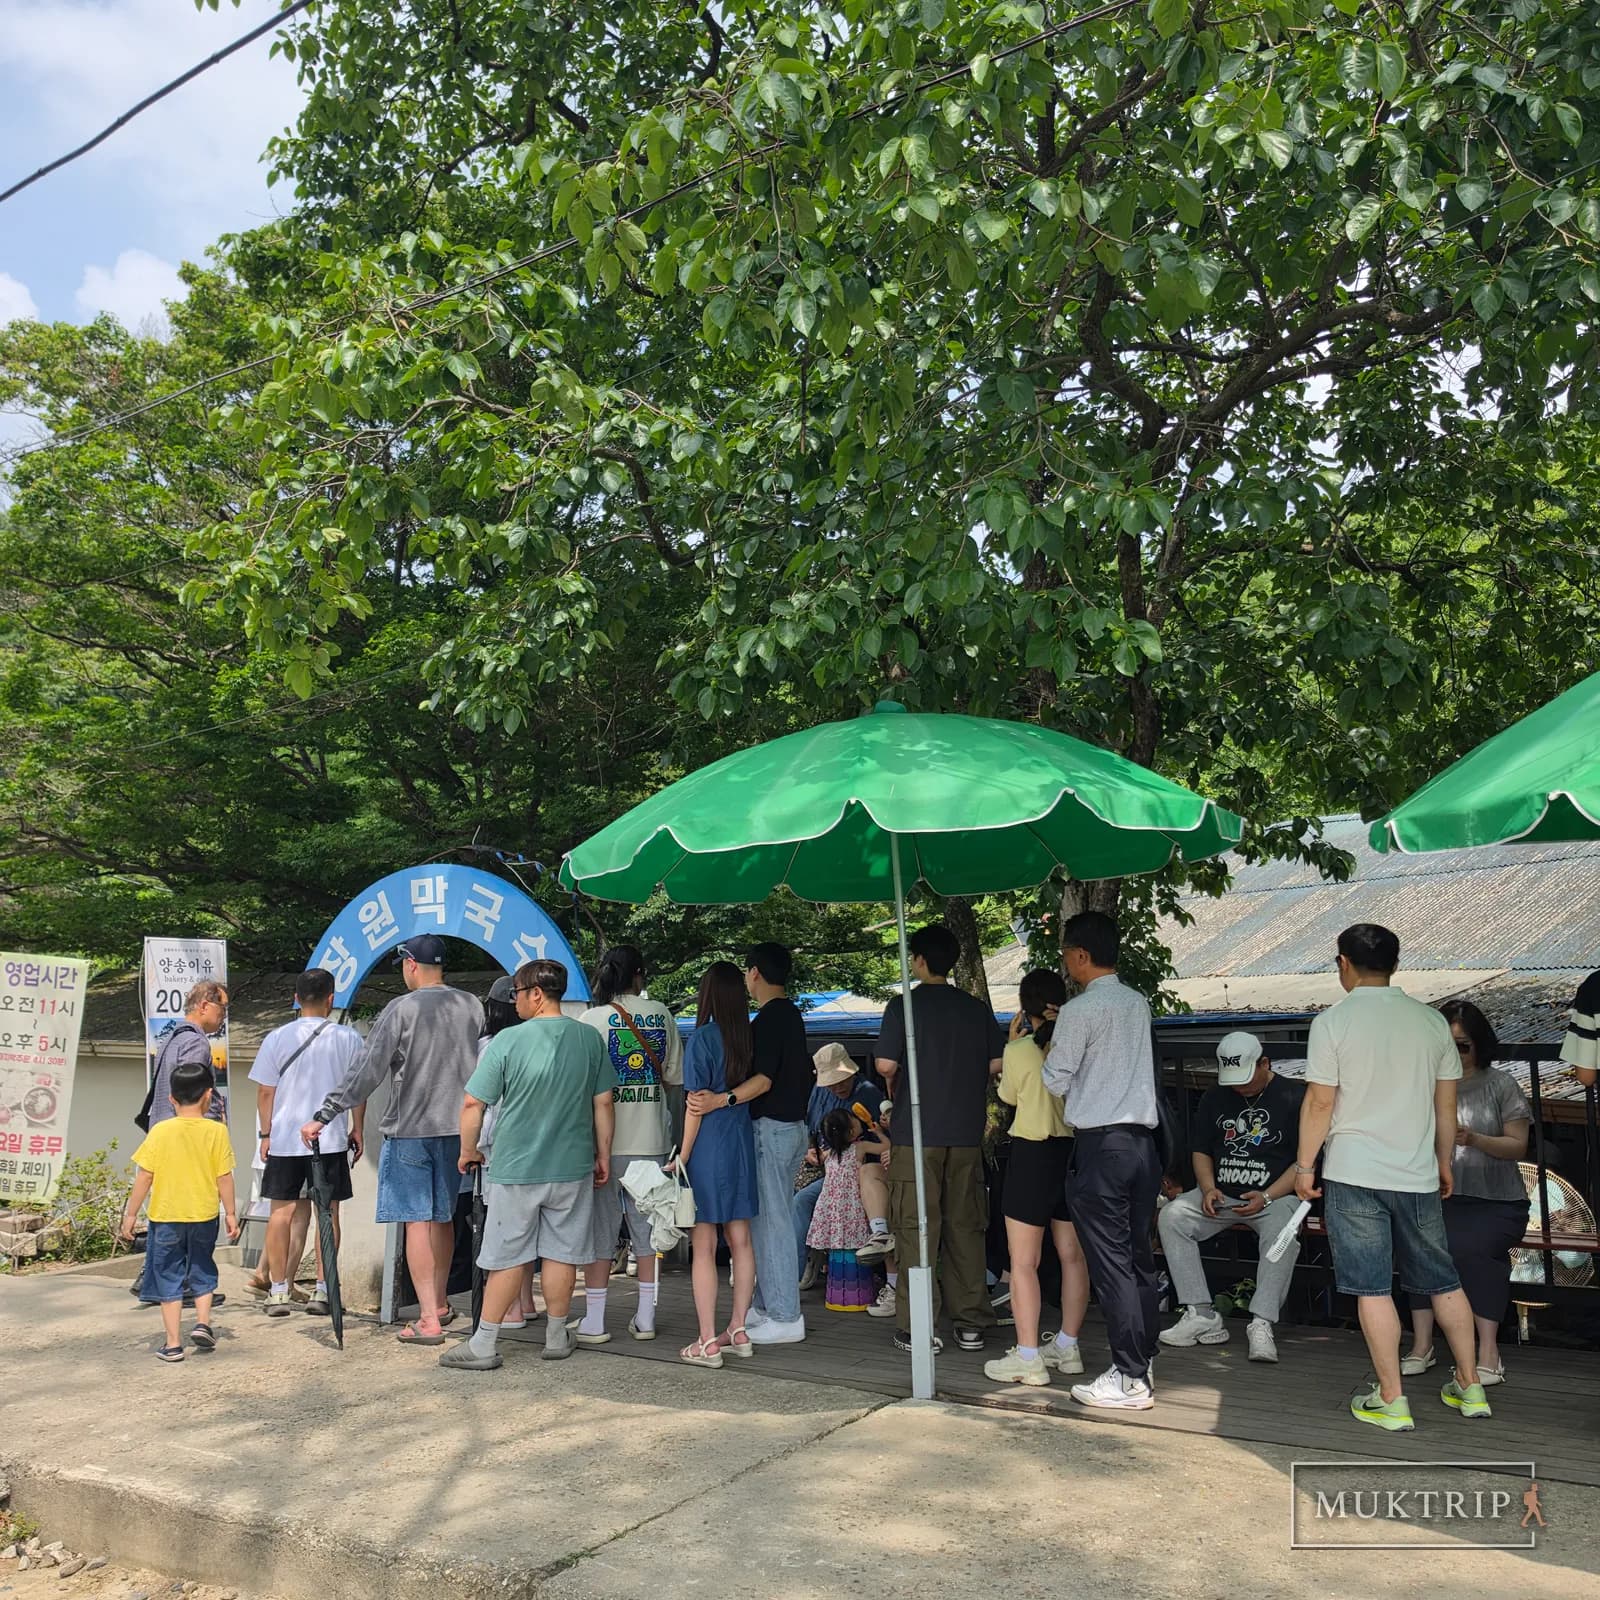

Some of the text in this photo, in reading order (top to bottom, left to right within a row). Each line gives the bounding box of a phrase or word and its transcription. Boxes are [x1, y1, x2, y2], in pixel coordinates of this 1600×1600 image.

[159, 957, 213, 974] 양송이유
[5, 962, 78, 990] 영업시간
[164, 975, 188, 984] bakery
[0, 995, 74, 1017] 오전 11시
[0, 1032, 67, 1053] 오후 5시
[612, 1087, 661, 1103] SMILE
[28, 1135, 63, 1157] 휴무
[1217, 1168, 1270, 1187] SNOOPY
